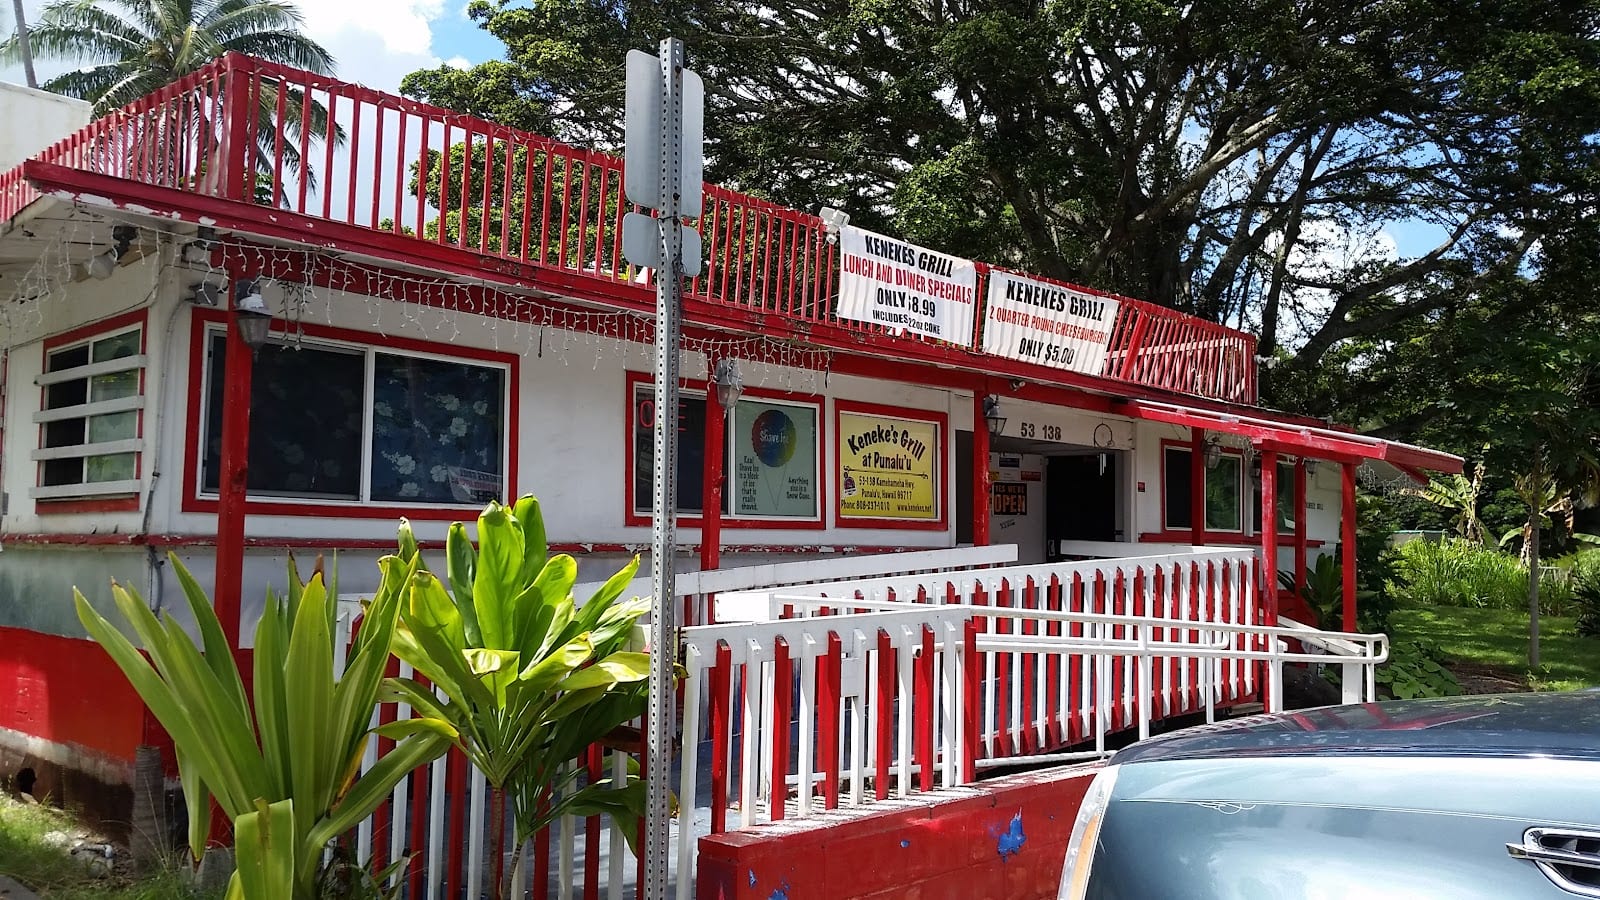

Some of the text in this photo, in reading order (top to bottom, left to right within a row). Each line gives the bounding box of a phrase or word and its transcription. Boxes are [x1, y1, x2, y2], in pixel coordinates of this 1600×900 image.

[865, 235, 953, 278] KENEKES GRILL
[843, 253, 873, 278] LUNCH
[876, 262, 892, 284] AND
[928, 278, 972, 305] SPECIALS
[877, 287, 906, 308] ONLY
[1006, 279, 1105, 322] KENEKES GRILL
[872, 309, 908, 324] INCLUDES
[924, 322, 941, 335] COKE
[989, 305, 1109, 345] 2 QUARTER POUND CHEESEBURGERS
[1018, 337, 1075, 364] ONLY $5.00
[760, 430, 779, 443] Shave
[847, 424, 926, 461] Keneke's Grill
[1021, 422, 1062, 440] 53 138
[862, 452, 912, 471] at Punalu'u
[859, 475, 876, 486] 53-138
[882, 490, 896, 500] Hawaii
[995, 494, 1026, 513] OPEN
